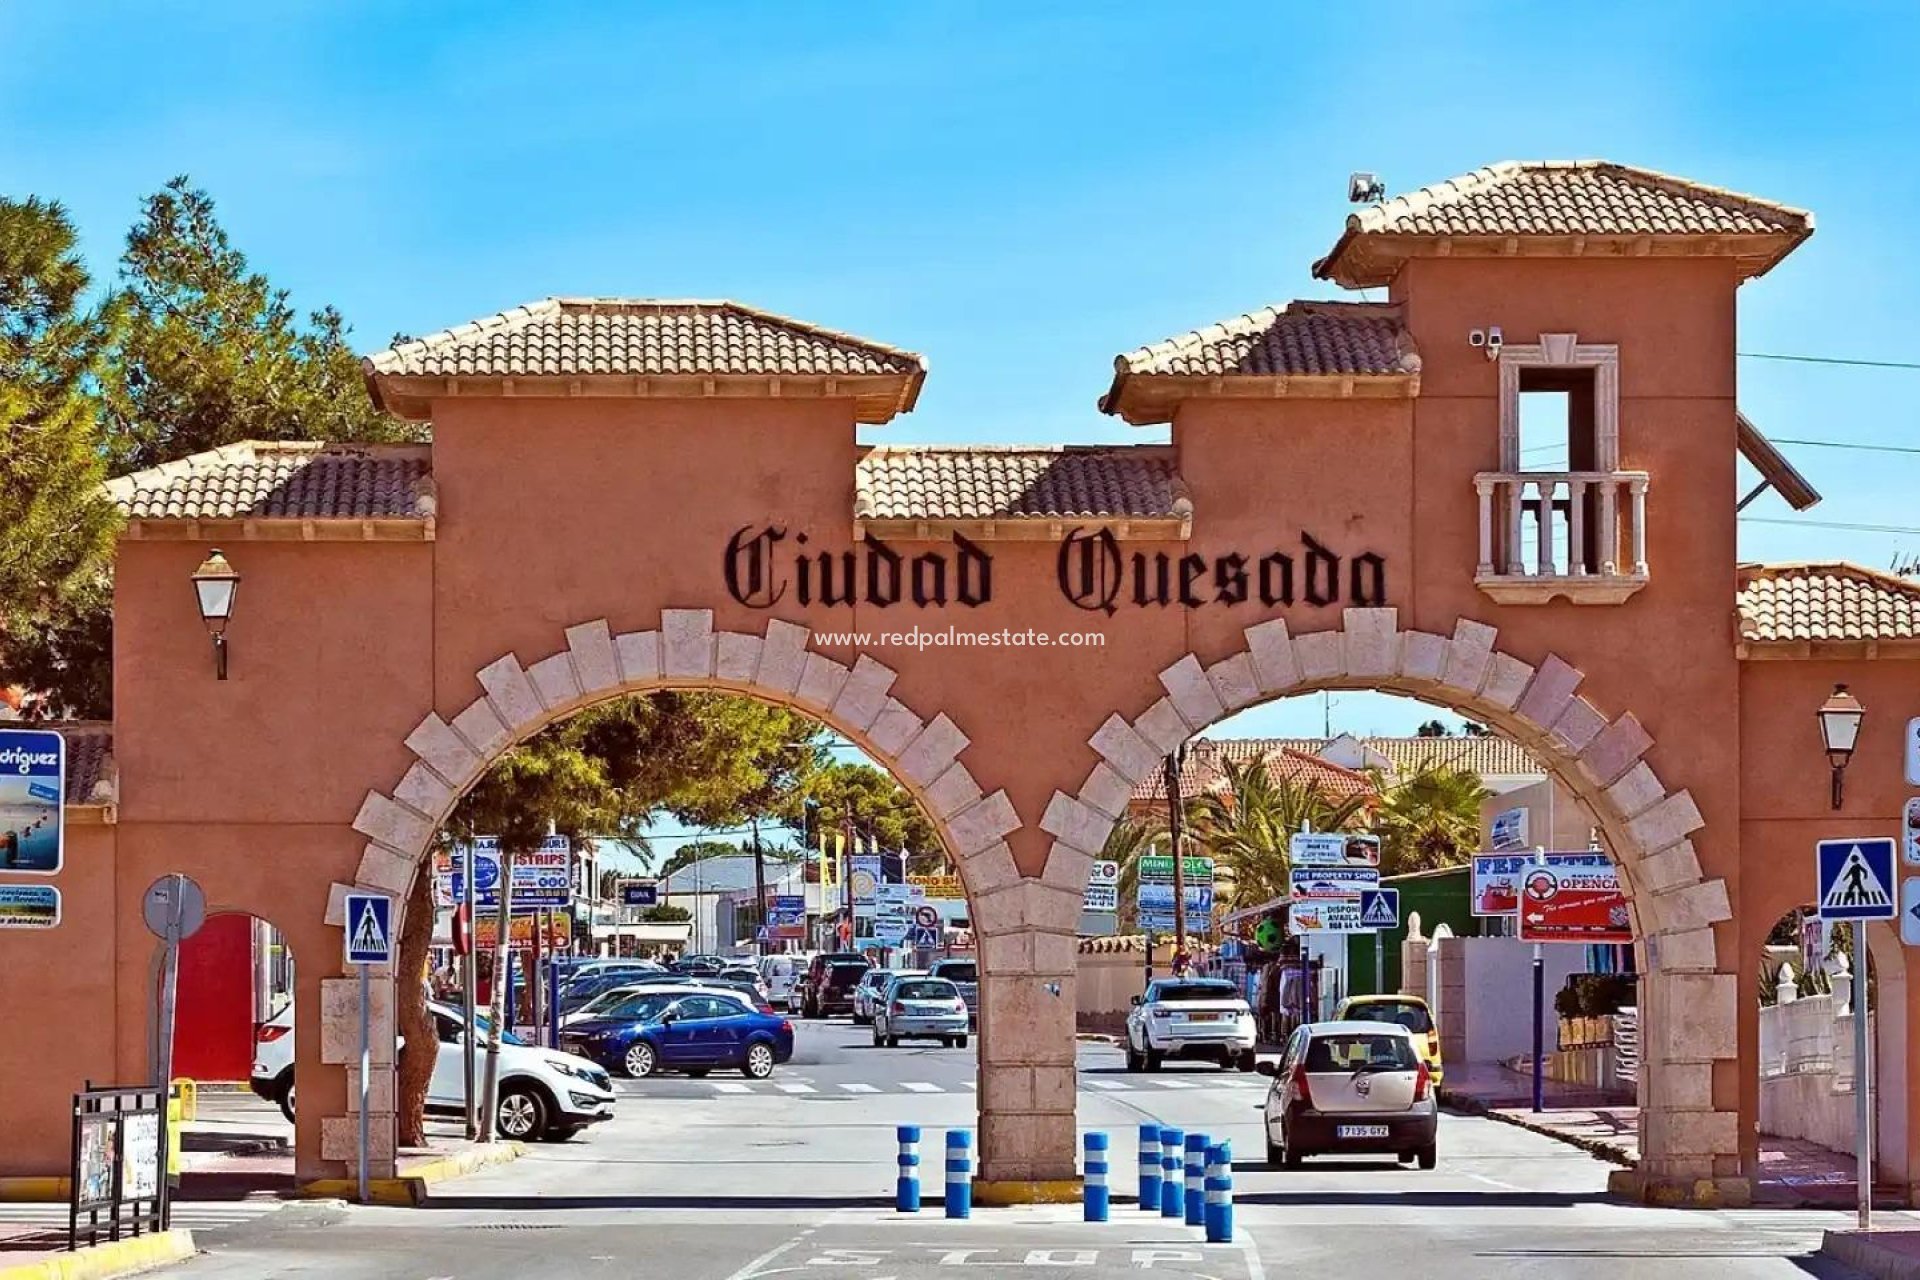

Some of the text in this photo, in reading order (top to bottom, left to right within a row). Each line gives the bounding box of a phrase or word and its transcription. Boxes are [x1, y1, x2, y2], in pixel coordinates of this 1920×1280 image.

[724, 525, 1387, 617] Ciudad Quesada
[1295, 871, 1377, 879] THE PROPERTY SHOP
[806, 1248, 1202, 1268] STOP
